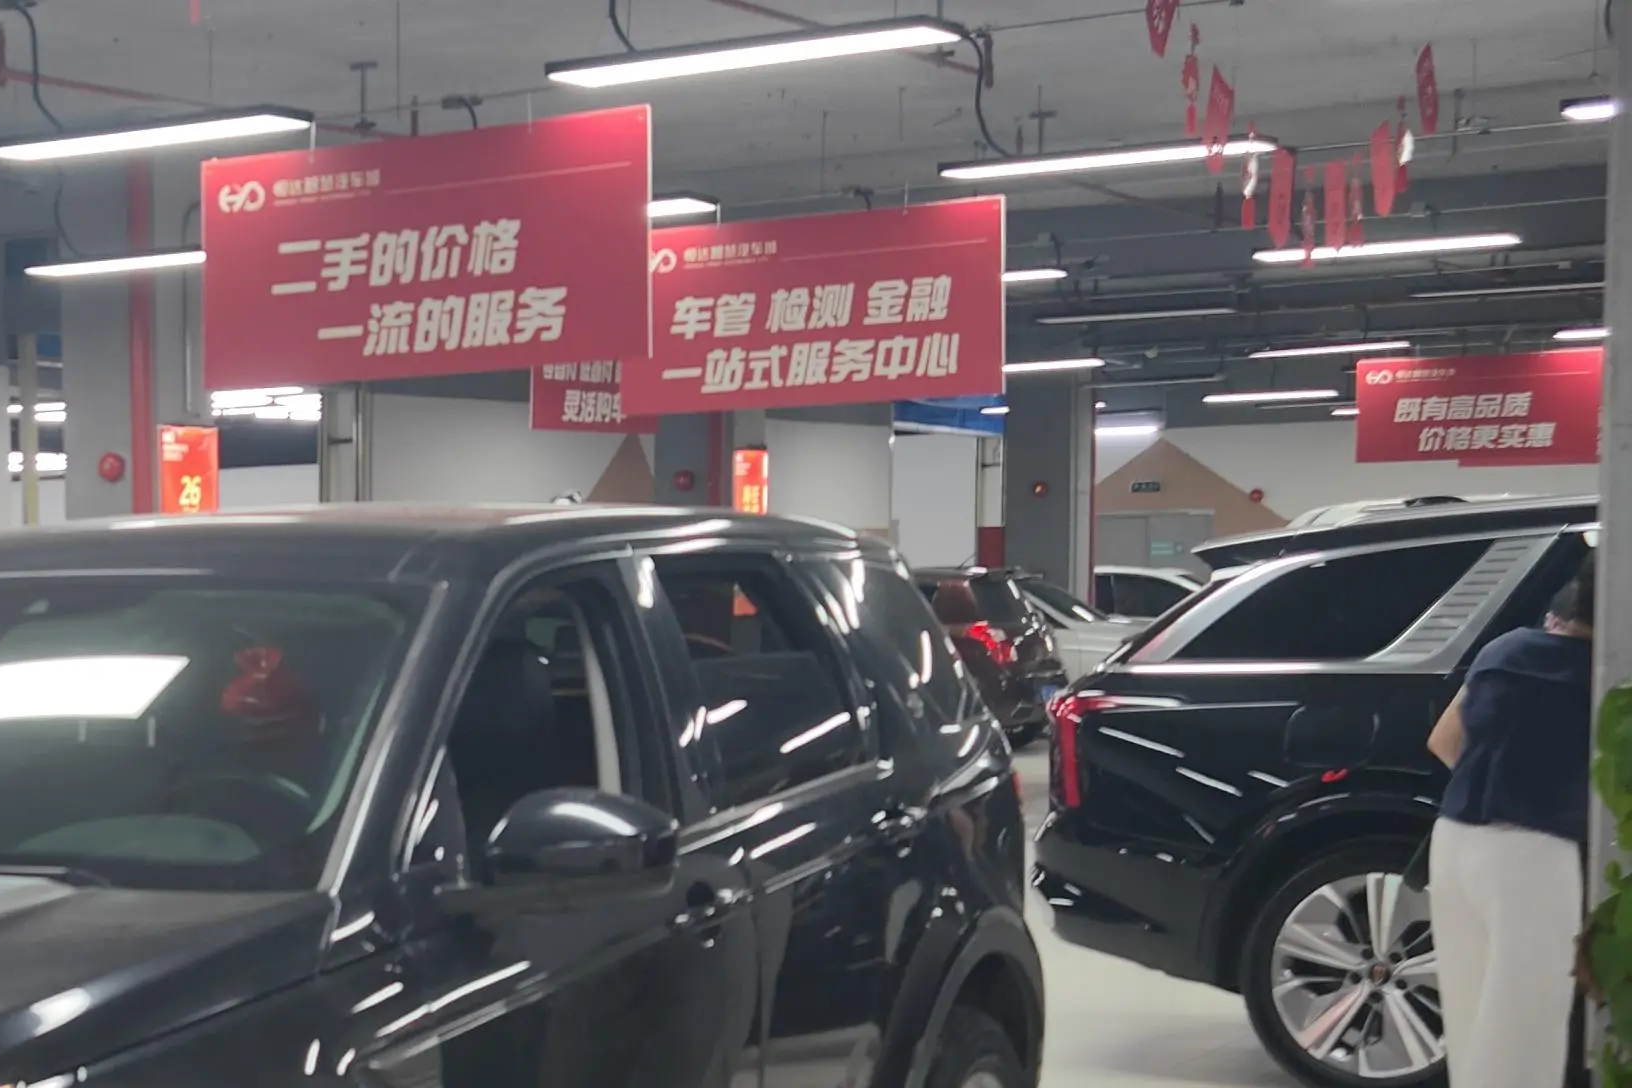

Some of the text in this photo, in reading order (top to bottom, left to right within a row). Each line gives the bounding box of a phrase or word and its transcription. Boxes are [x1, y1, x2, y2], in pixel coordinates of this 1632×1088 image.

[270, 218, 521, 295] 二手的价格
[317, 286, 568, 356] 一流的服务
[670, 274, 953, 340] 车管 检测 金融
[661, 331, 961, 394] 一站式服务中心
[1393, 391, 1533, 424] 既有高品质
[1417, 422, 1557, 452] 价格更实惠
[178, 474, 203, 506] 26
